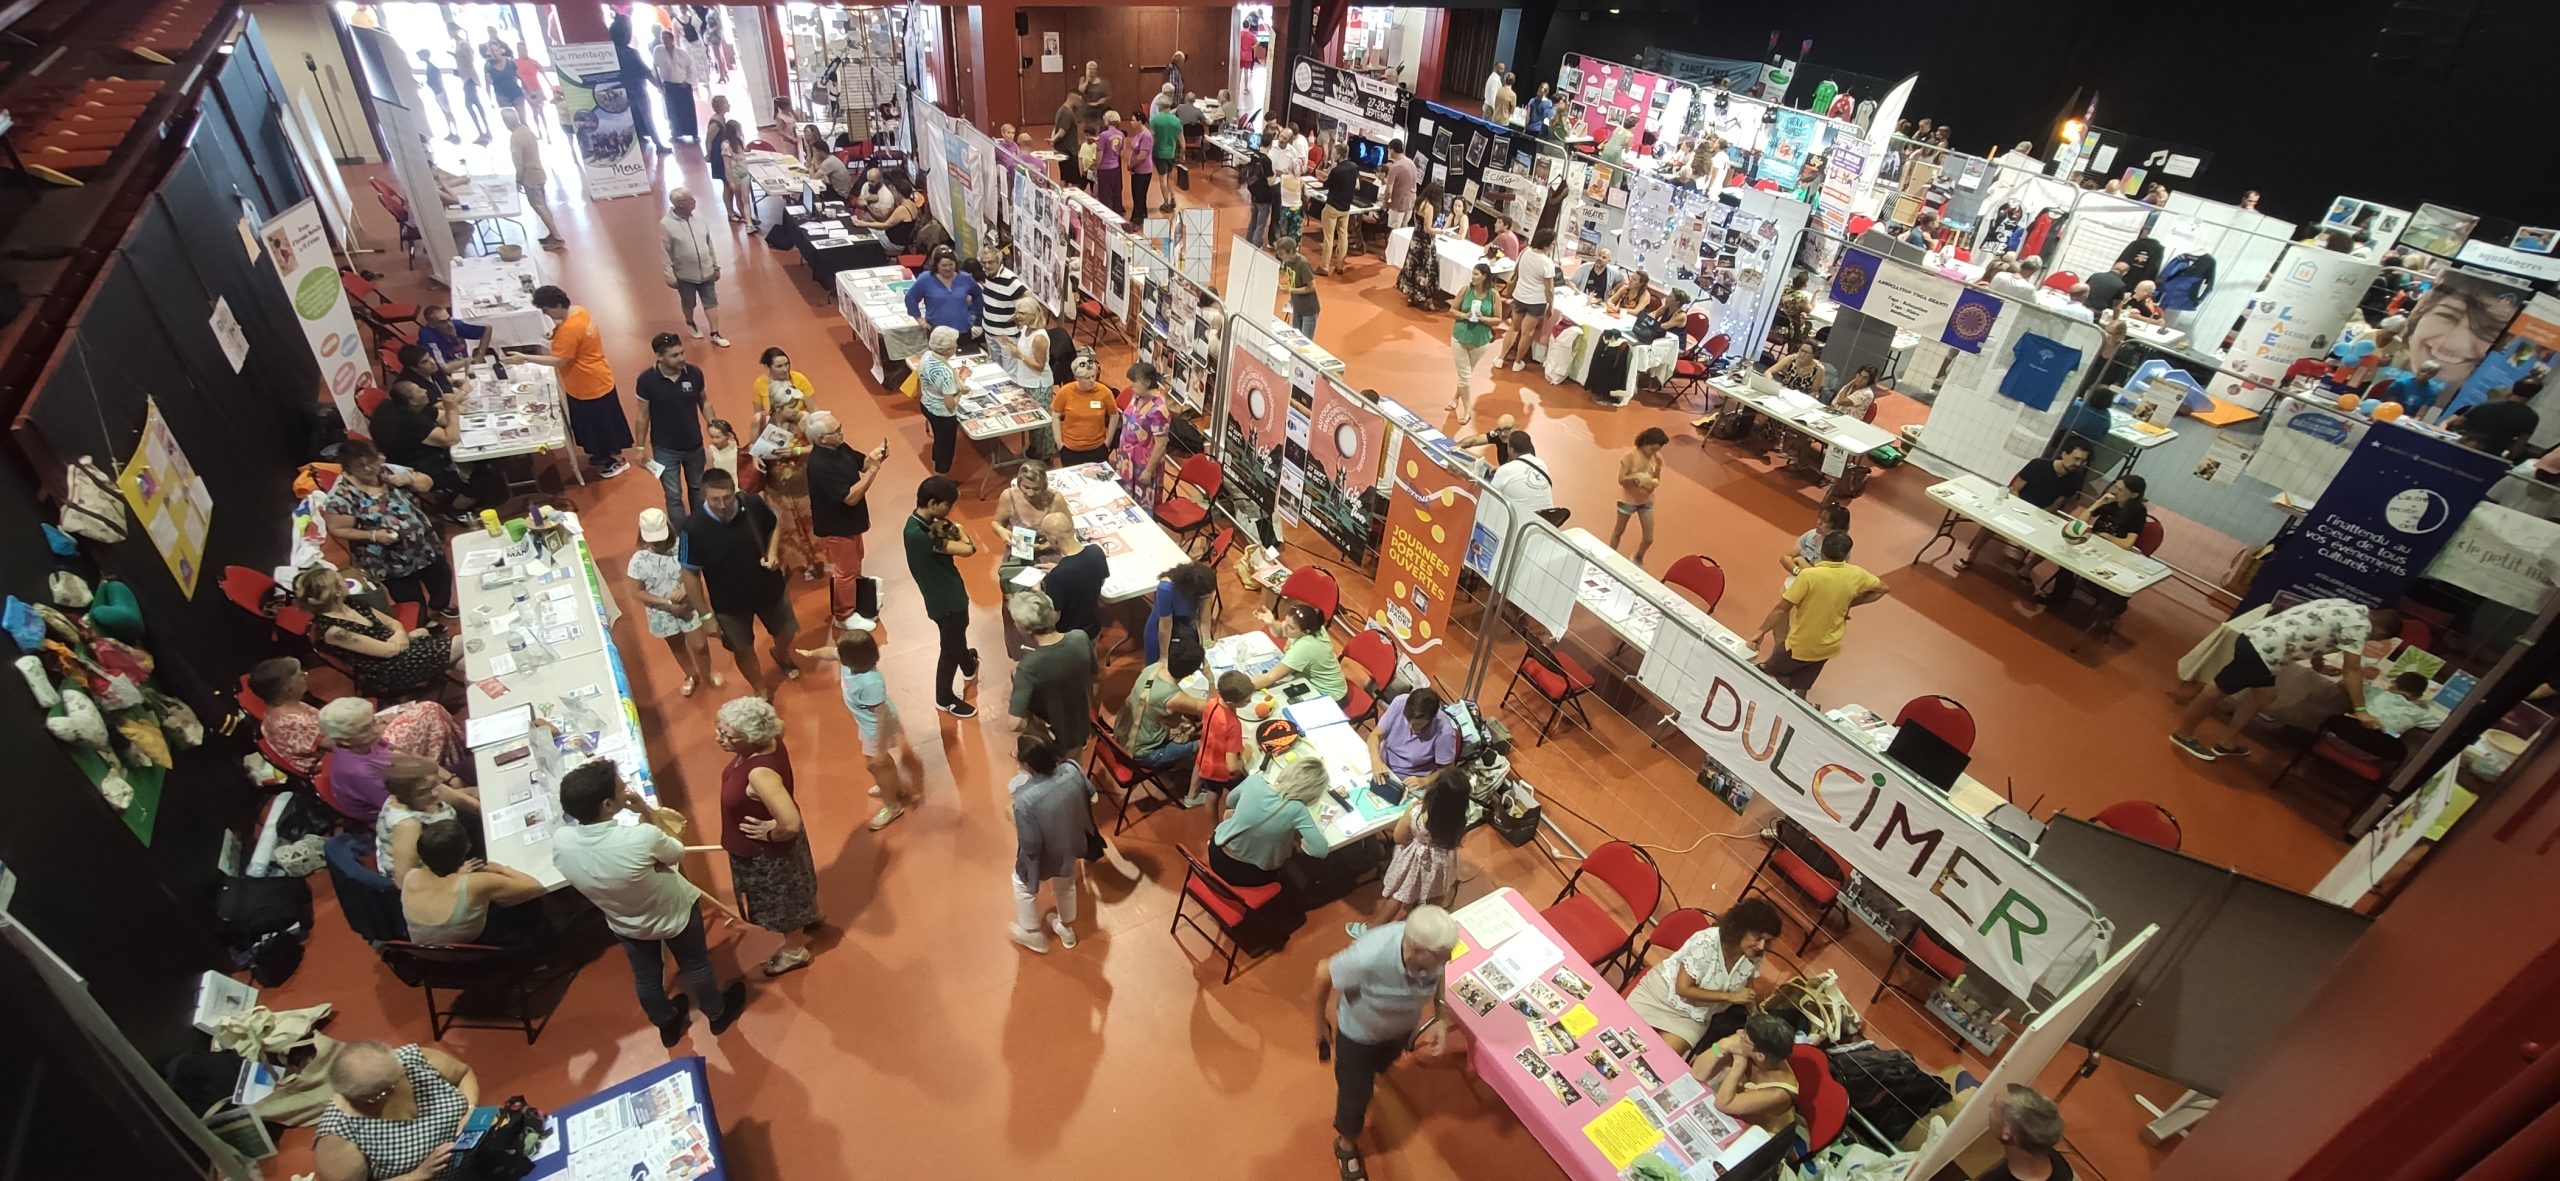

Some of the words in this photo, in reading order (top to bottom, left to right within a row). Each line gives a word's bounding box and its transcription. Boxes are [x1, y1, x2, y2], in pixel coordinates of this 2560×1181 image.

[2478, 251, 2543, 271] aqualangres
[2305, 530, 2327, 544] vos
[2393, 543, 2412, 554] au
[1390, 535, 1434, 577] PORTES
[2356, 540, 2374, 551] de
[2377, 547, 2407, 565] tous
[2479, 550, 2523, 573] petit
[1389, 547, 1445, 601] OUVERTES
